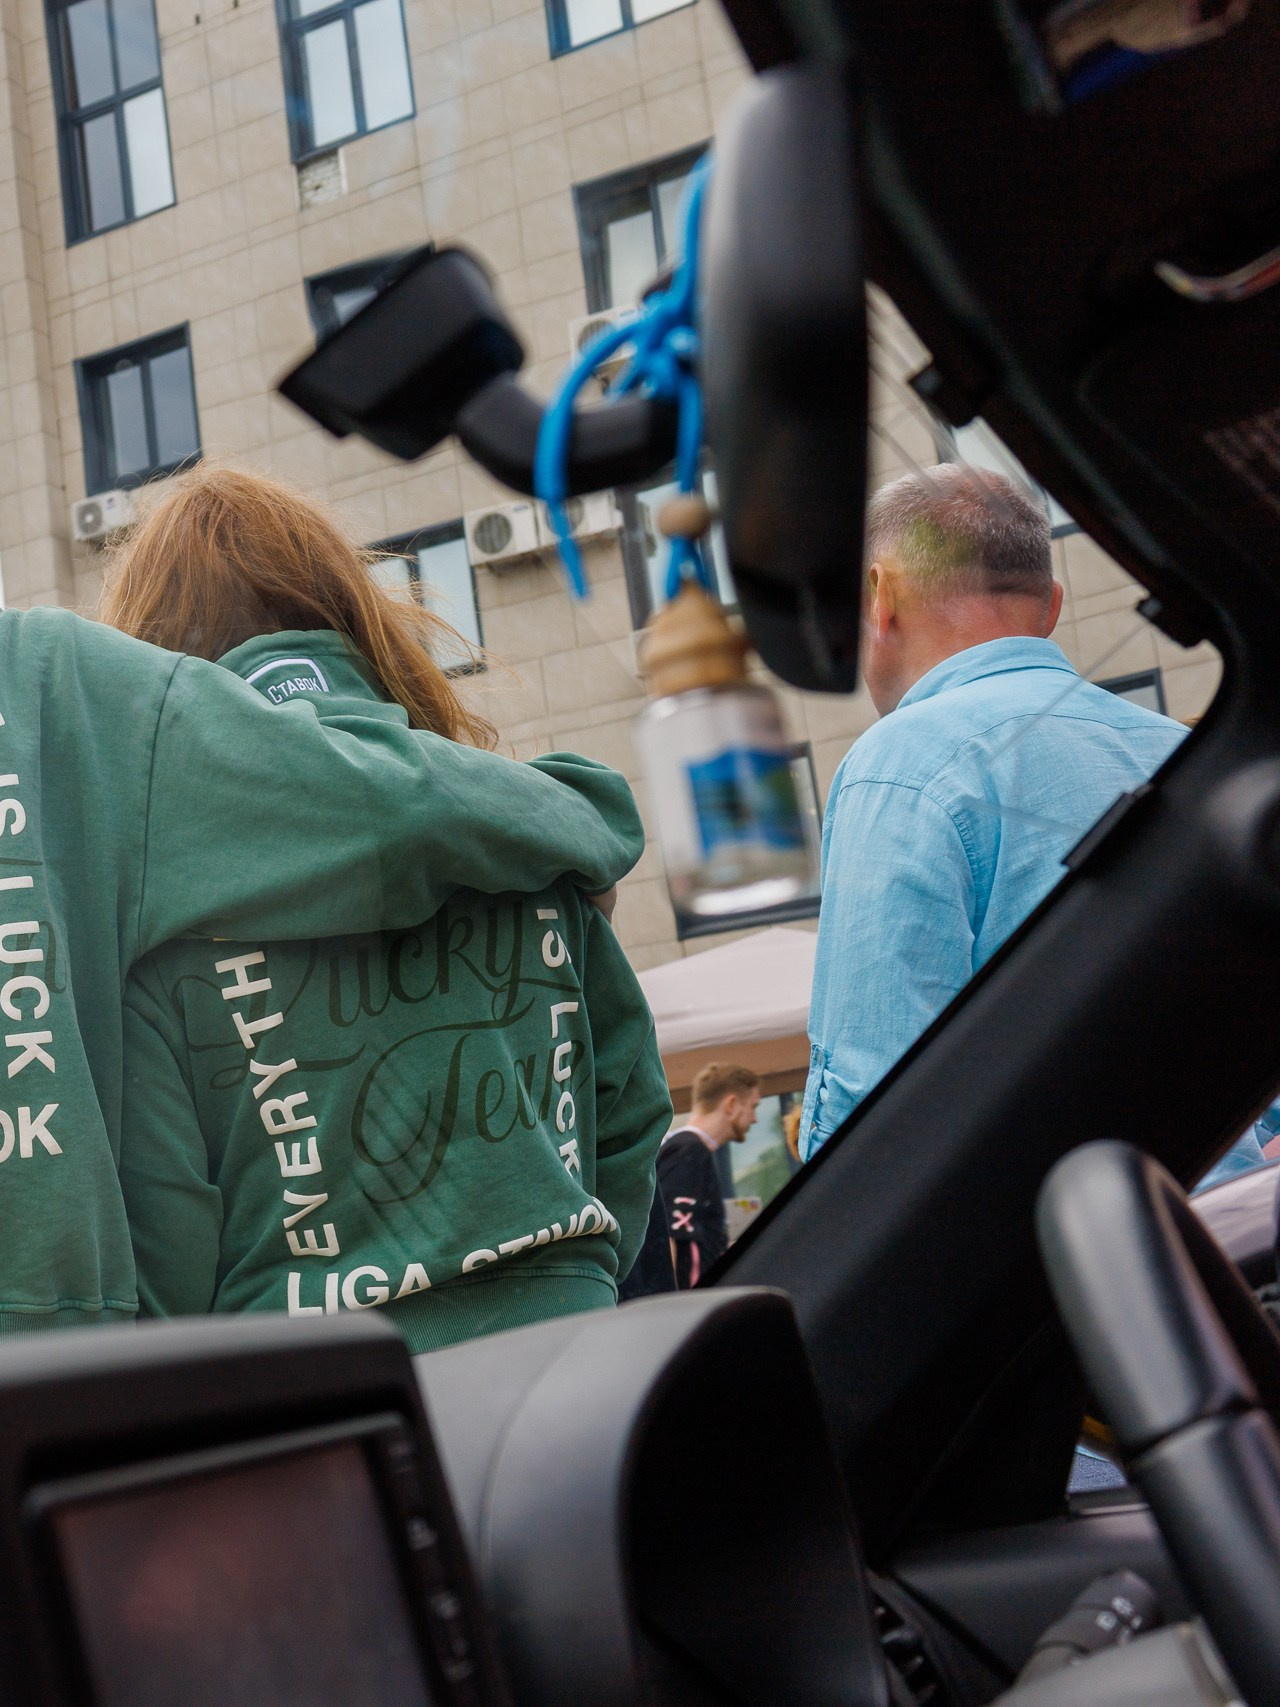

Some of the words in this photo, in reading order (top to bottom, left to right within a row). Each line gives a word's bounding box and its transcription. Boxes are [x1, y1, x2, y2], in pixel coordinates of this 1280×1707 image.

[213, 937, 341, 1258] EVERYTH
[549, 1000, 584, 1179] LUCK
[287, 1262, 433, 1318] LIGA
